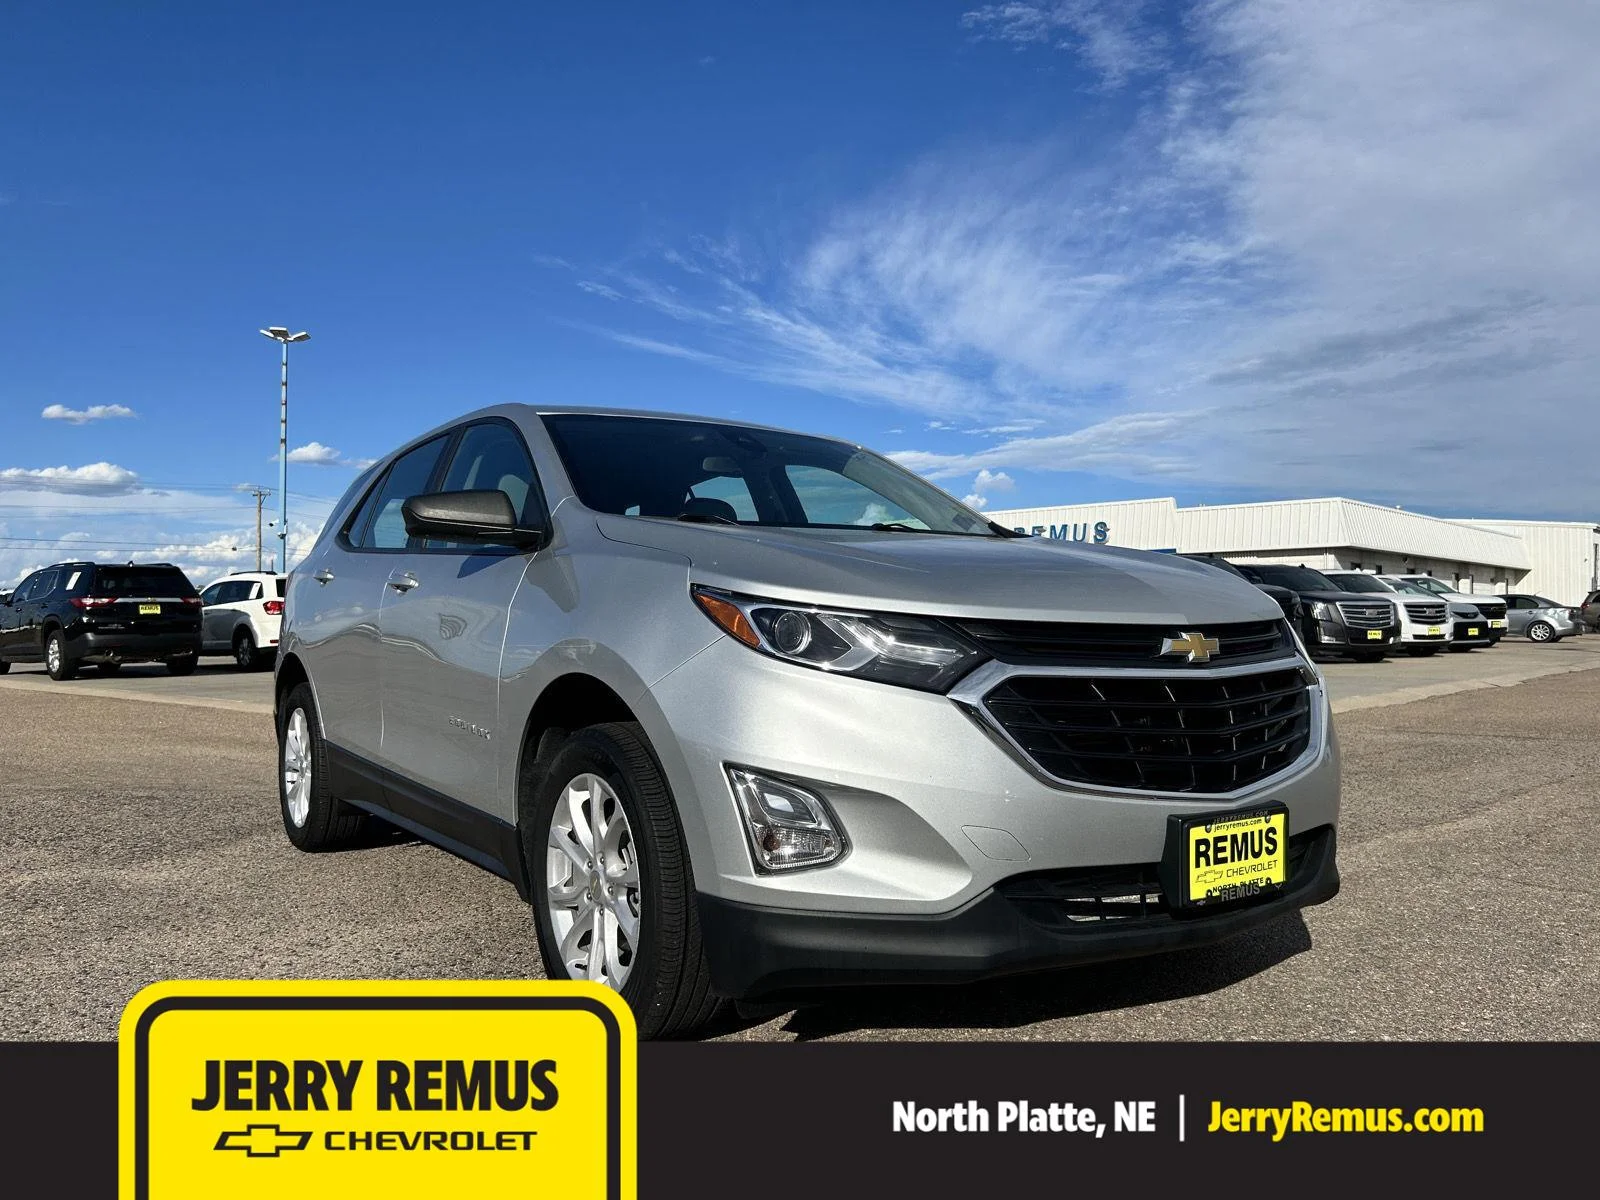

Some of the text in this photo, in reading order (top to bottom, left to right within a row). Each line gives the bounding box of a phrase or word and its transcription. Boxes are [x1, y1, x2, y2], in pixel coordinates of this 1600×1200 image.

[1213, 818, 1262, 832] jerryremus.com
[1194, 827, 1278, 869] REMUS
[1226, 860, 1278, 878] CHEVROLET
[1221, 883, 1260, 902] REMUS
